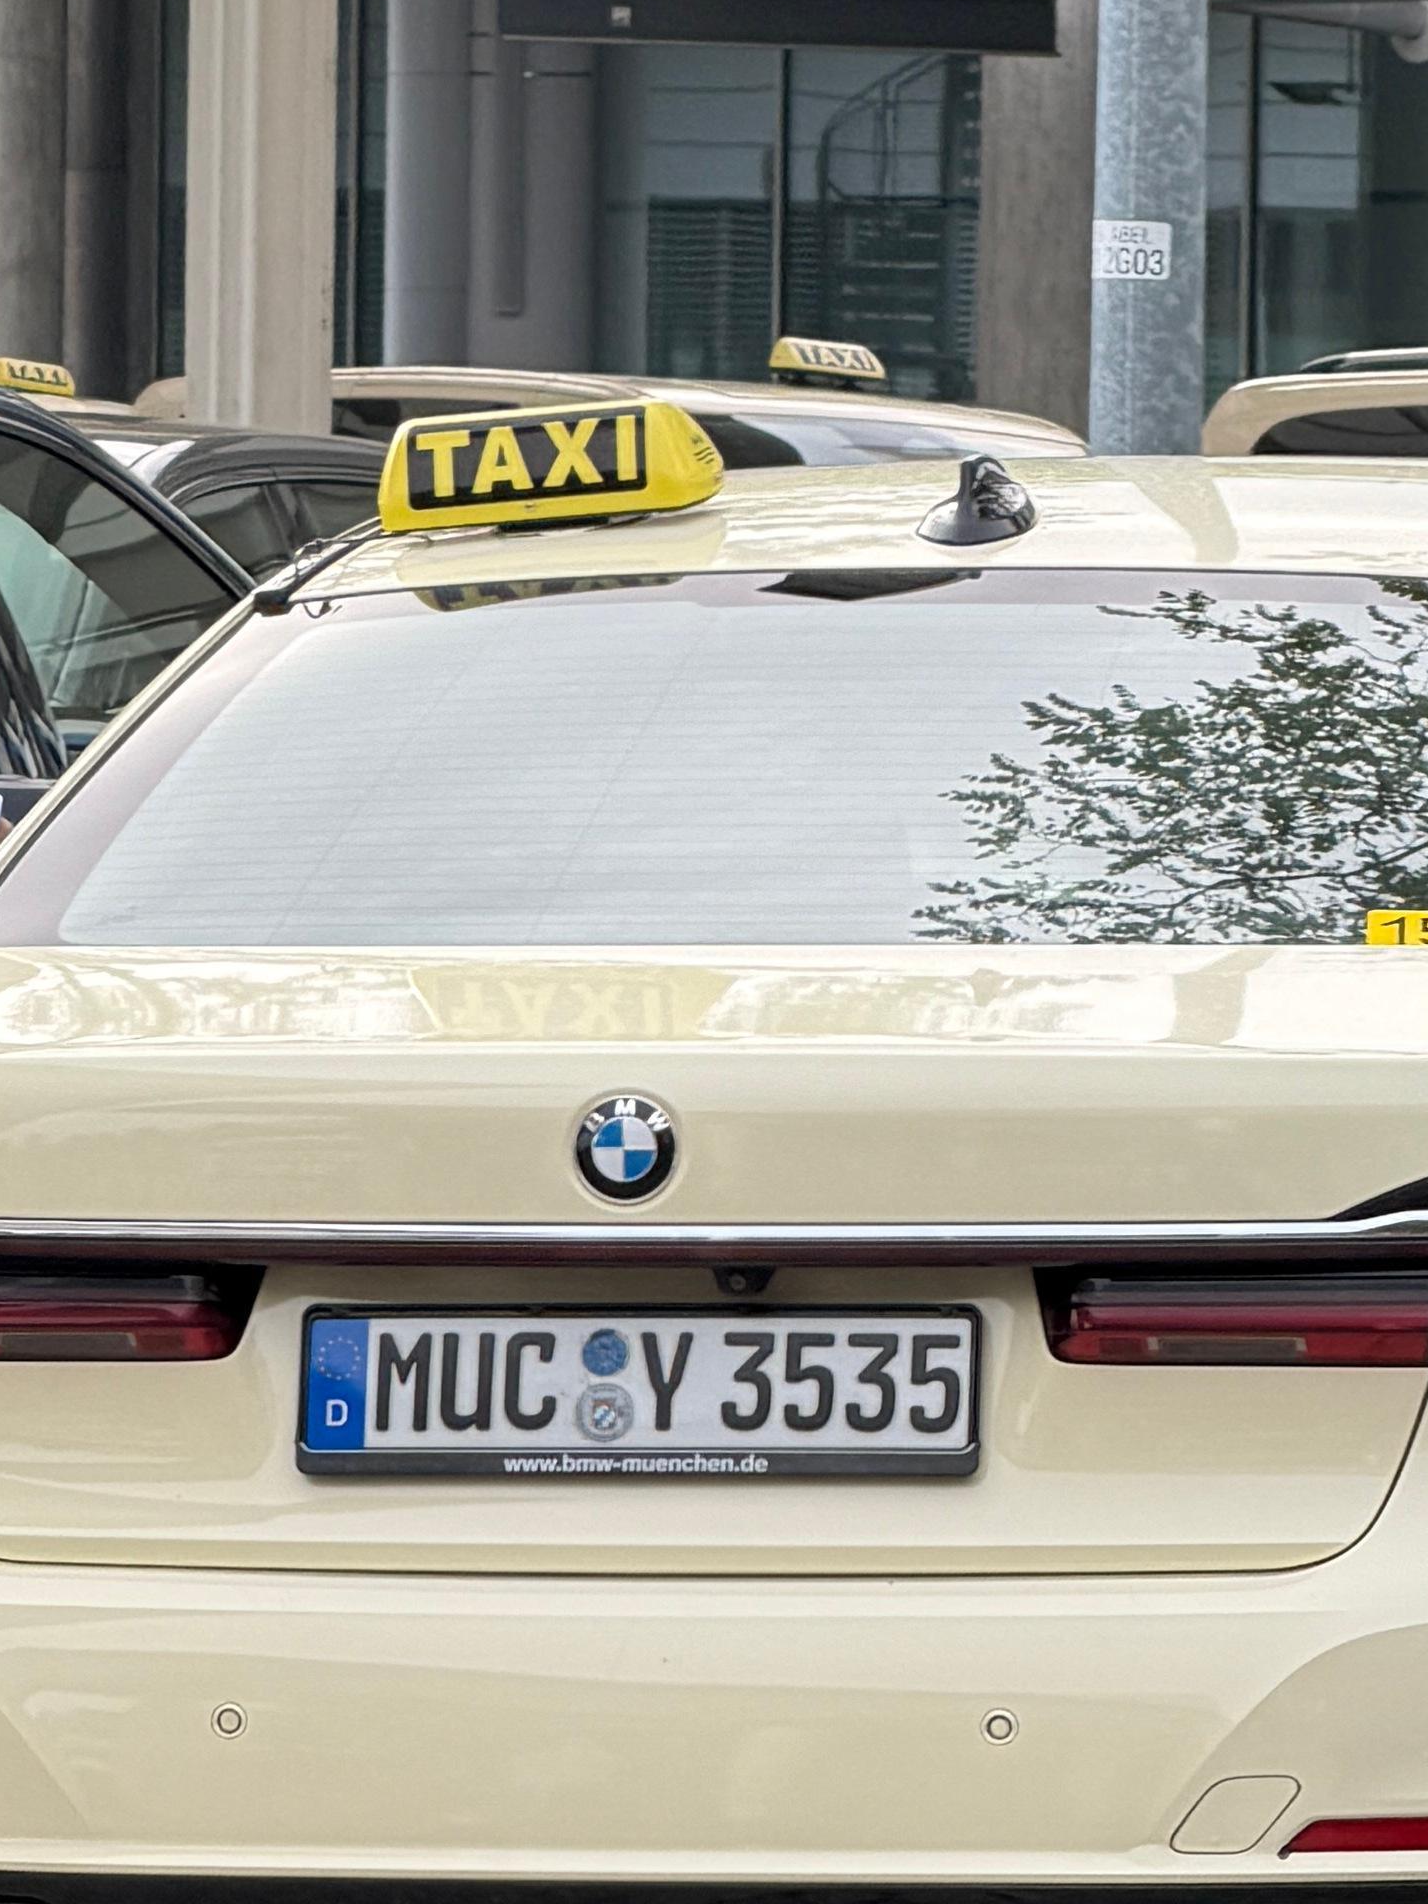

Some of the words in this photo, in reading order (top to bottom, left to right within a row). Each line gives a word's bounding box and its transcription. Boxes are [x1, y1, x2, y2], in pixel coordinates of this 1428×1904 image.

[796, 342, 875, 371] TAXI
[416, 414, 638, 498] TAXI
[584, 1097, 671, 1133] BMW
[375, 1331, 556, 1433] MUC
[642, 1331, 693, 1432] Y
[720, 1332, 962, 1434] 3535
[325, 1398, 349, 1427] D
[503, 1453, 769, 1475] www.bmw-muenchen.de
